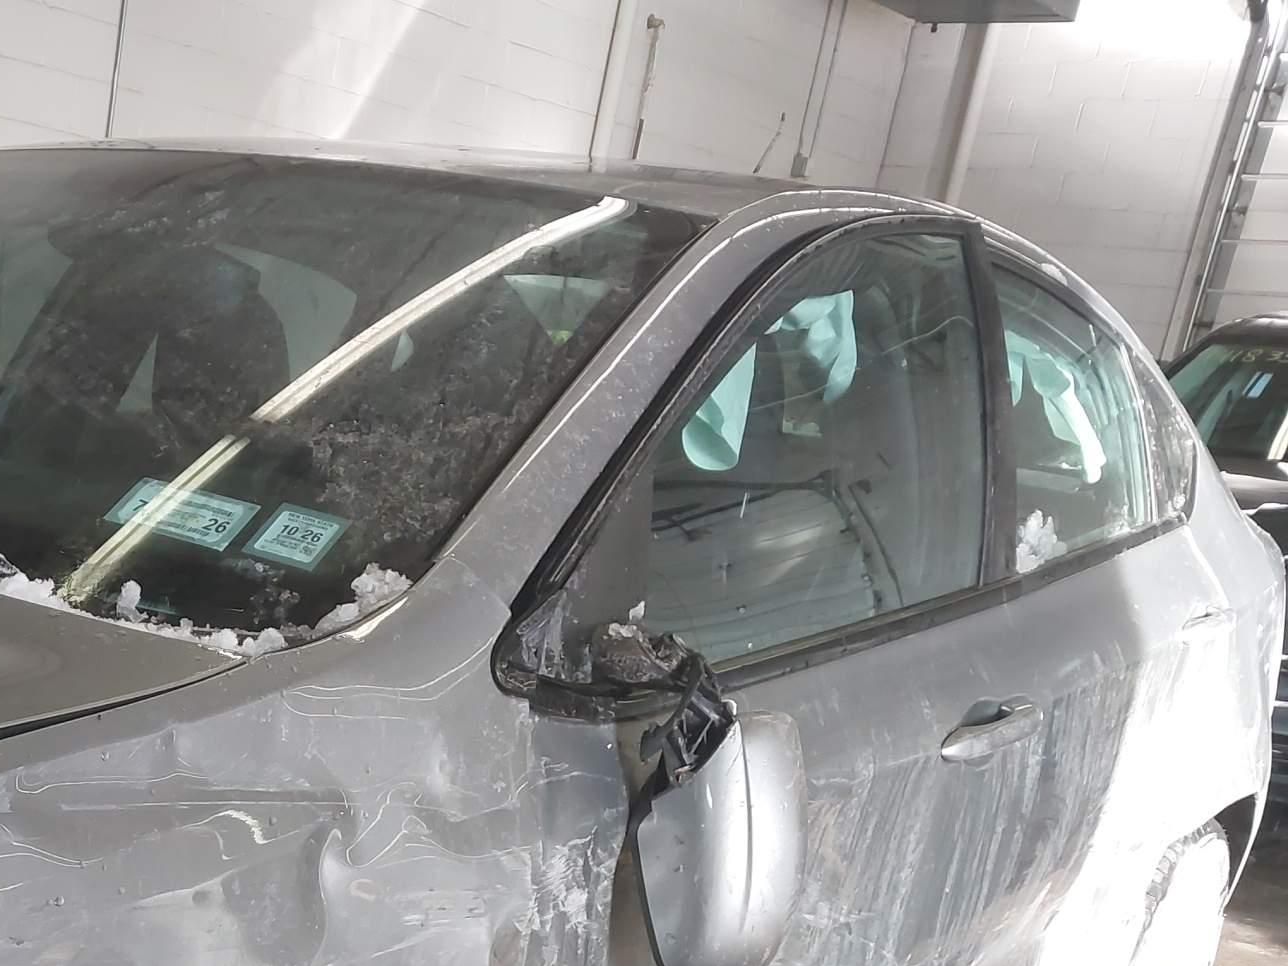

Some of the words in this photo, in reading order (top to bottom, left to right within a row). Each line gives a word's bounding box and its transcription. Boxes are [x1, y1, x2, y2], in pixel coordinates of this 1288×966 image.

[202, 517, 230, 533] 26
[280, 524, 299, 536] 10
[301, 529, 324, 543] 26
